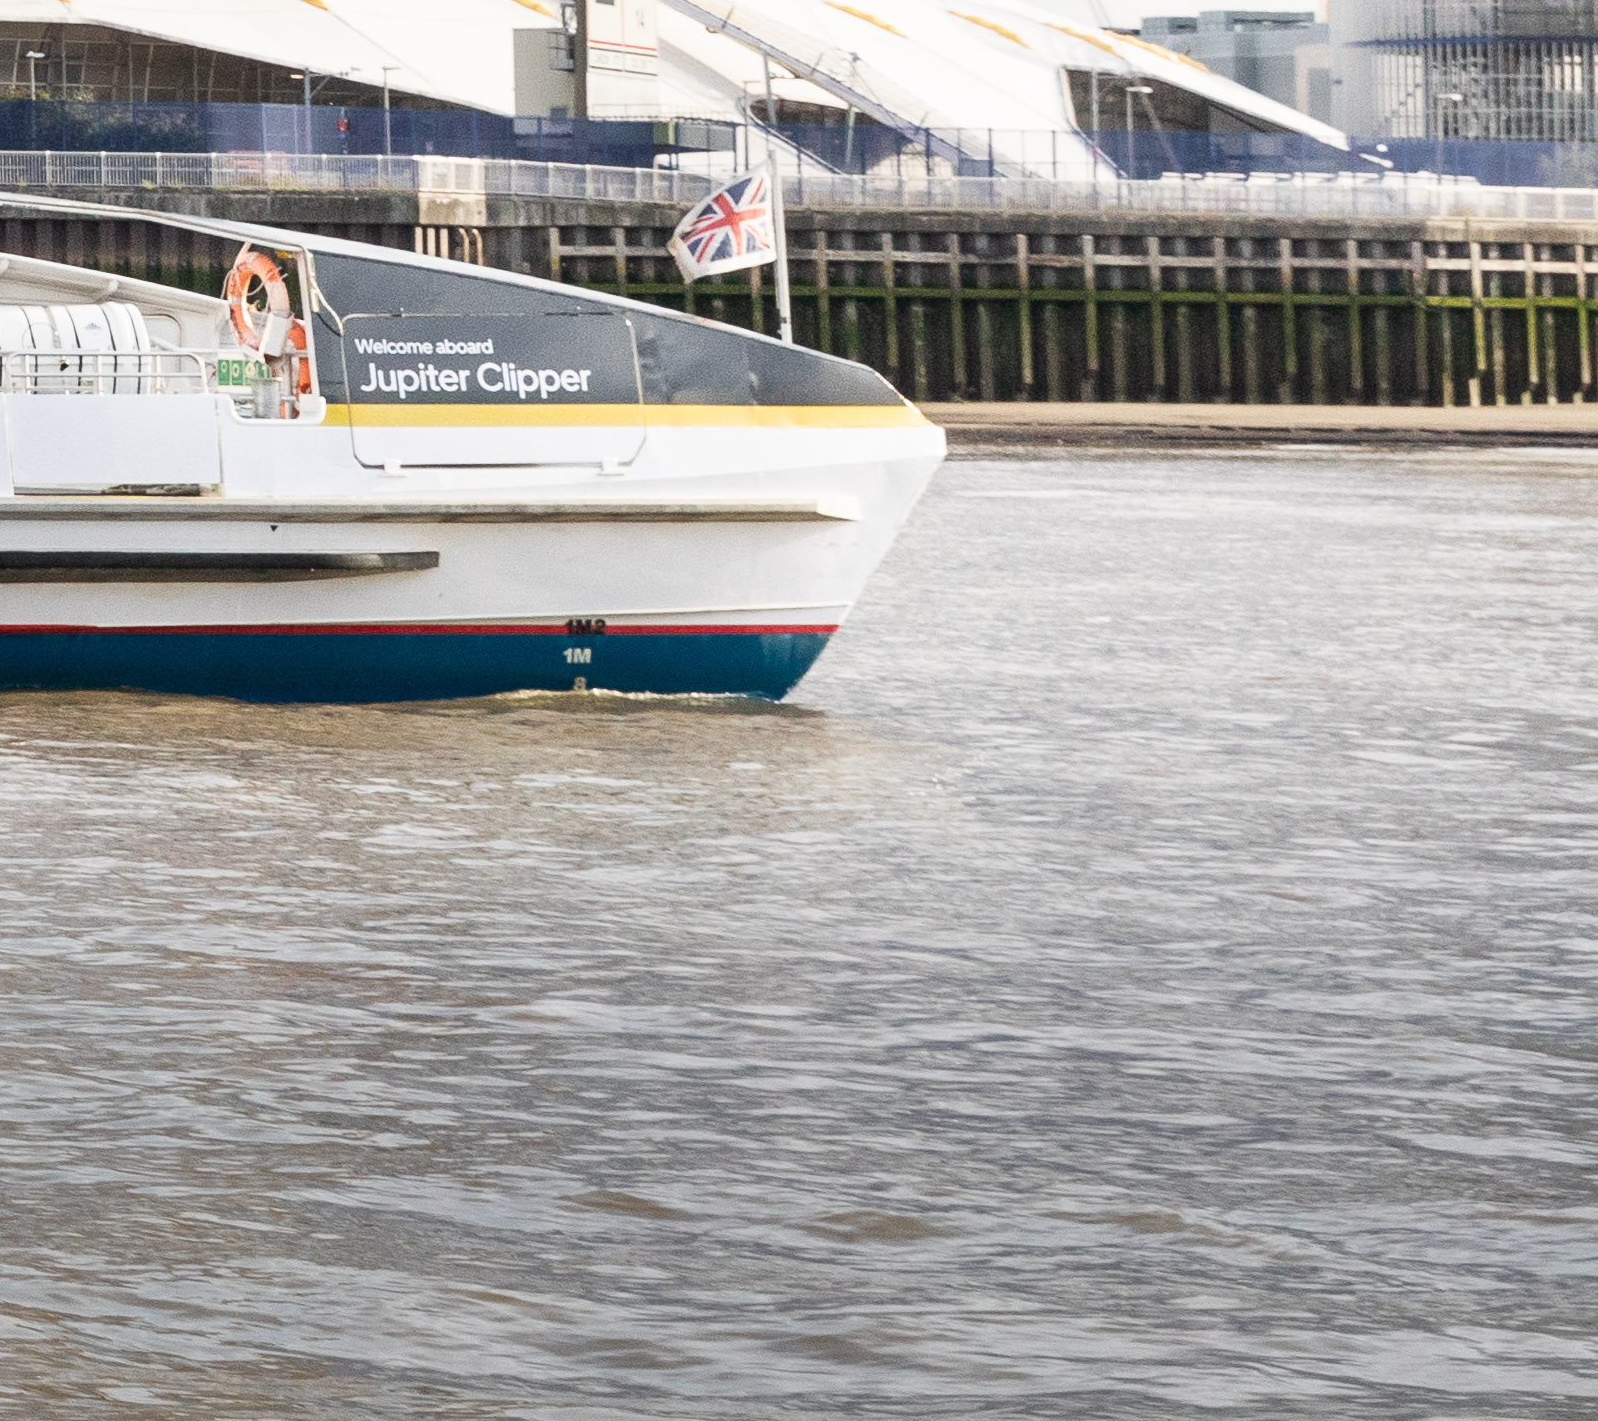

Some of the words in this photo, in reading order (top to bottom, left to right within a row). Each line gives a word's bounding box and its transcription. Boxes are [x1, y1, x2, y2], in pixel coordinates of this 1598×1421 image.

[354, 338, 433, 355] Welcome
[436, 338, 494, 355] aboard
[360, 362, 470, 400] Jupiter
[476, 362, 592, 400] Clipper
[565, 619, 606, 634] 1M2
[563, 648, 592, 664] 1M
